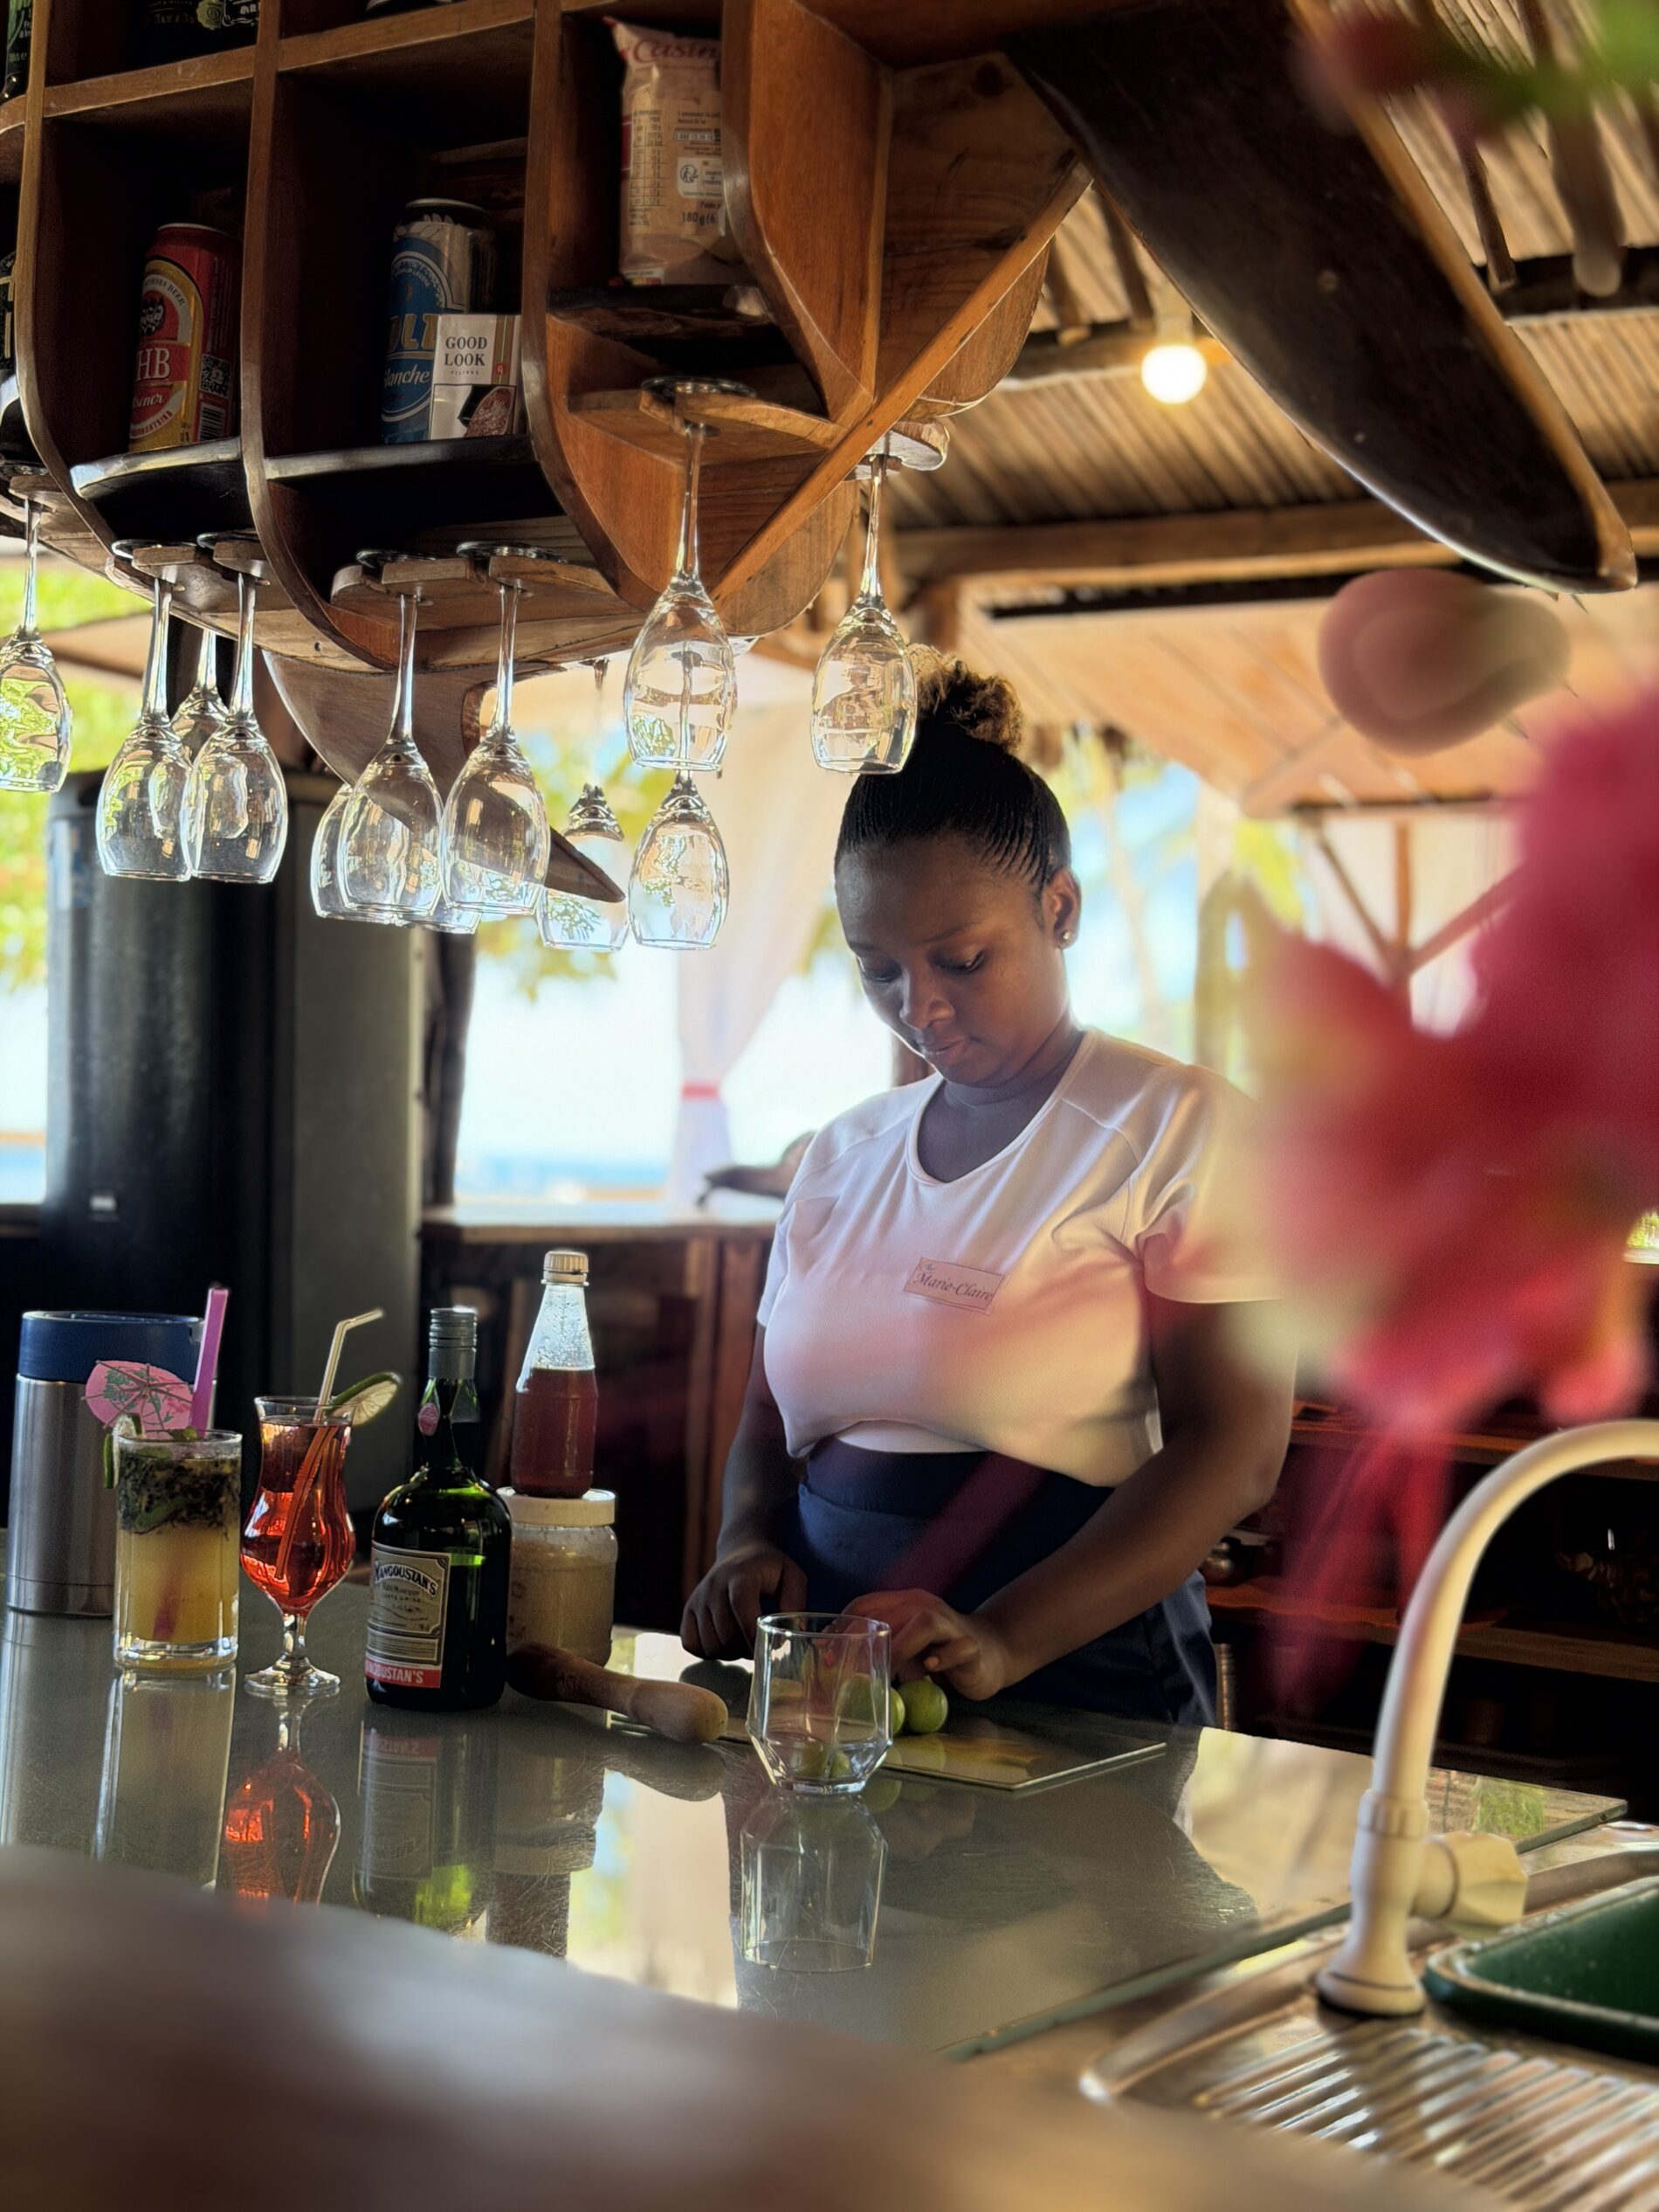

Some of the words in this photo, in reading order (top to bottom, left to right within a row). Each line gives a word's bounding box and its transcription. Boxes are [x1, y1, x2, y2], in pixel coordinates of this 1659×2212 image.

[445, 336, 487, 350] GOOD
[444, 353, 485, 366] LOOK
[913, 1272, 994, 1300] Marie-Claire
